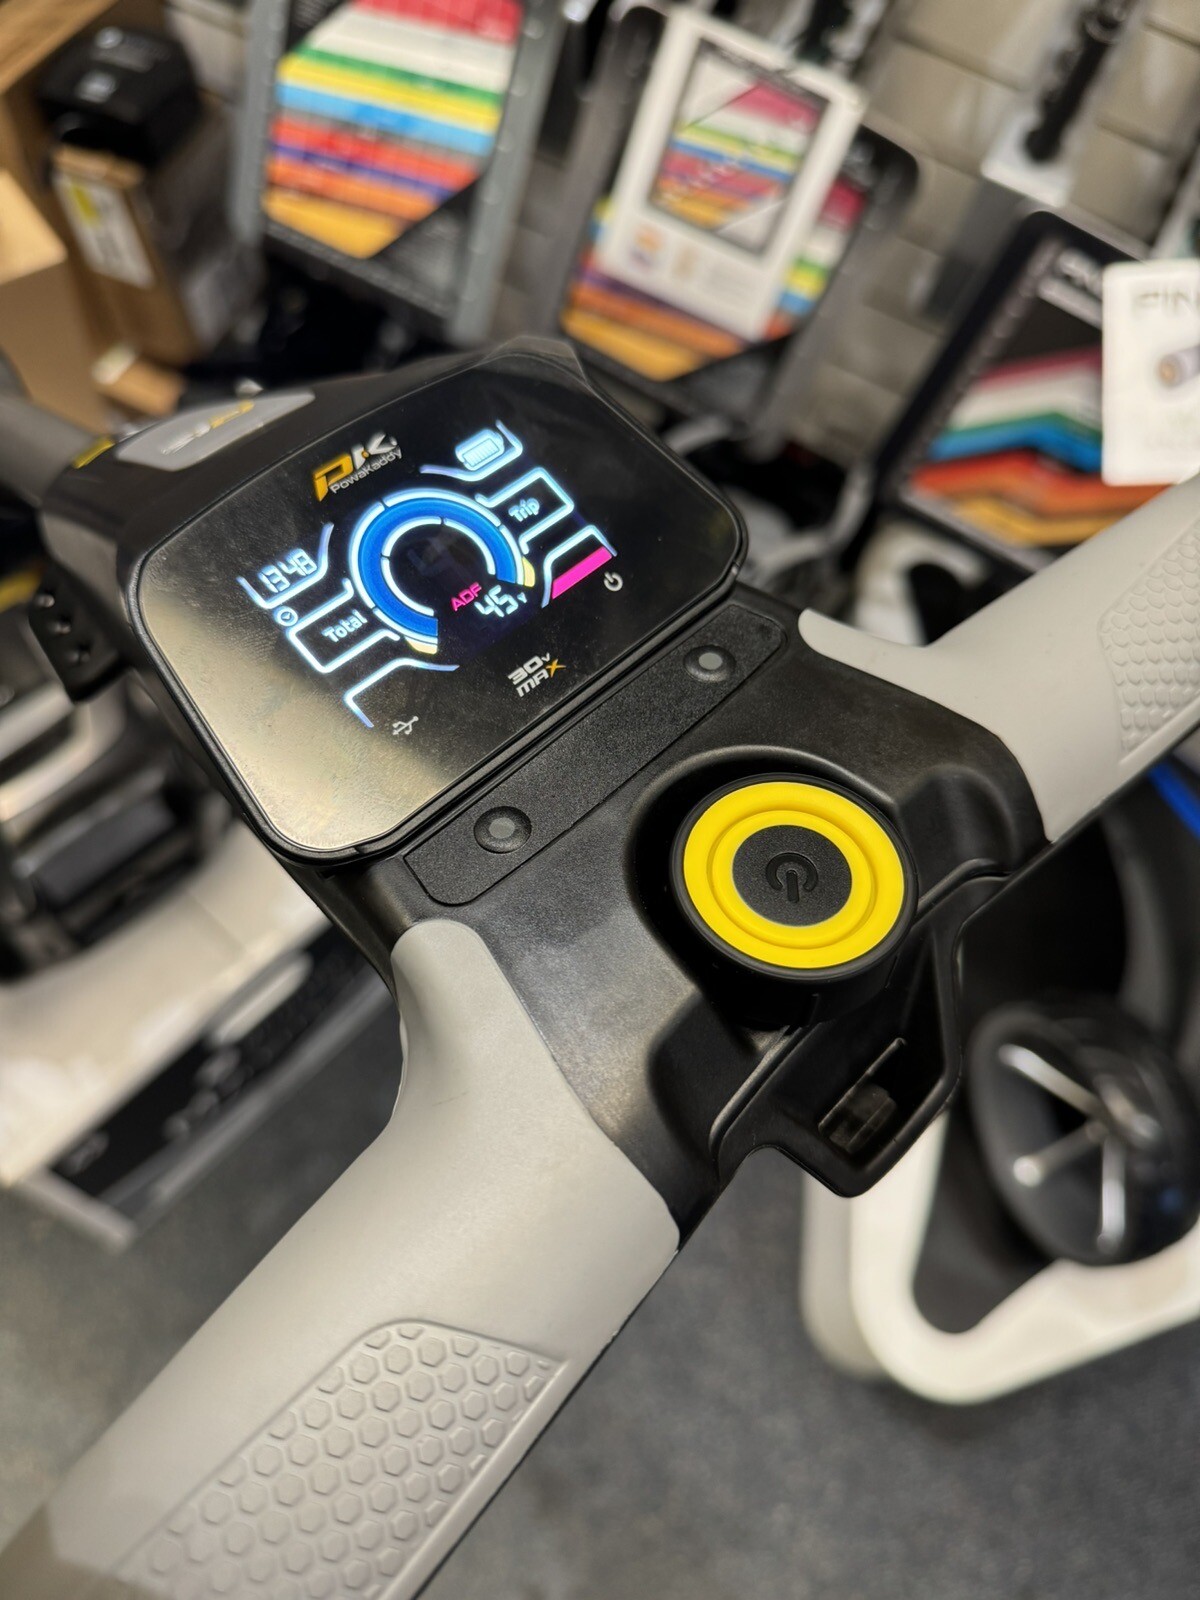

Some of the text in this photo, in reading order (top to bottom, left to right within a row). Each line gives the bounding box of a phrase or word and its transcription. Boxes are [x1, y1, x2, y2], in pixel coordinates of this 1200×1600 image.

[508, 497, 540, 522] Trip
[451, 582, 482, 612] ADF
[321, 609, 368, 643] Total
